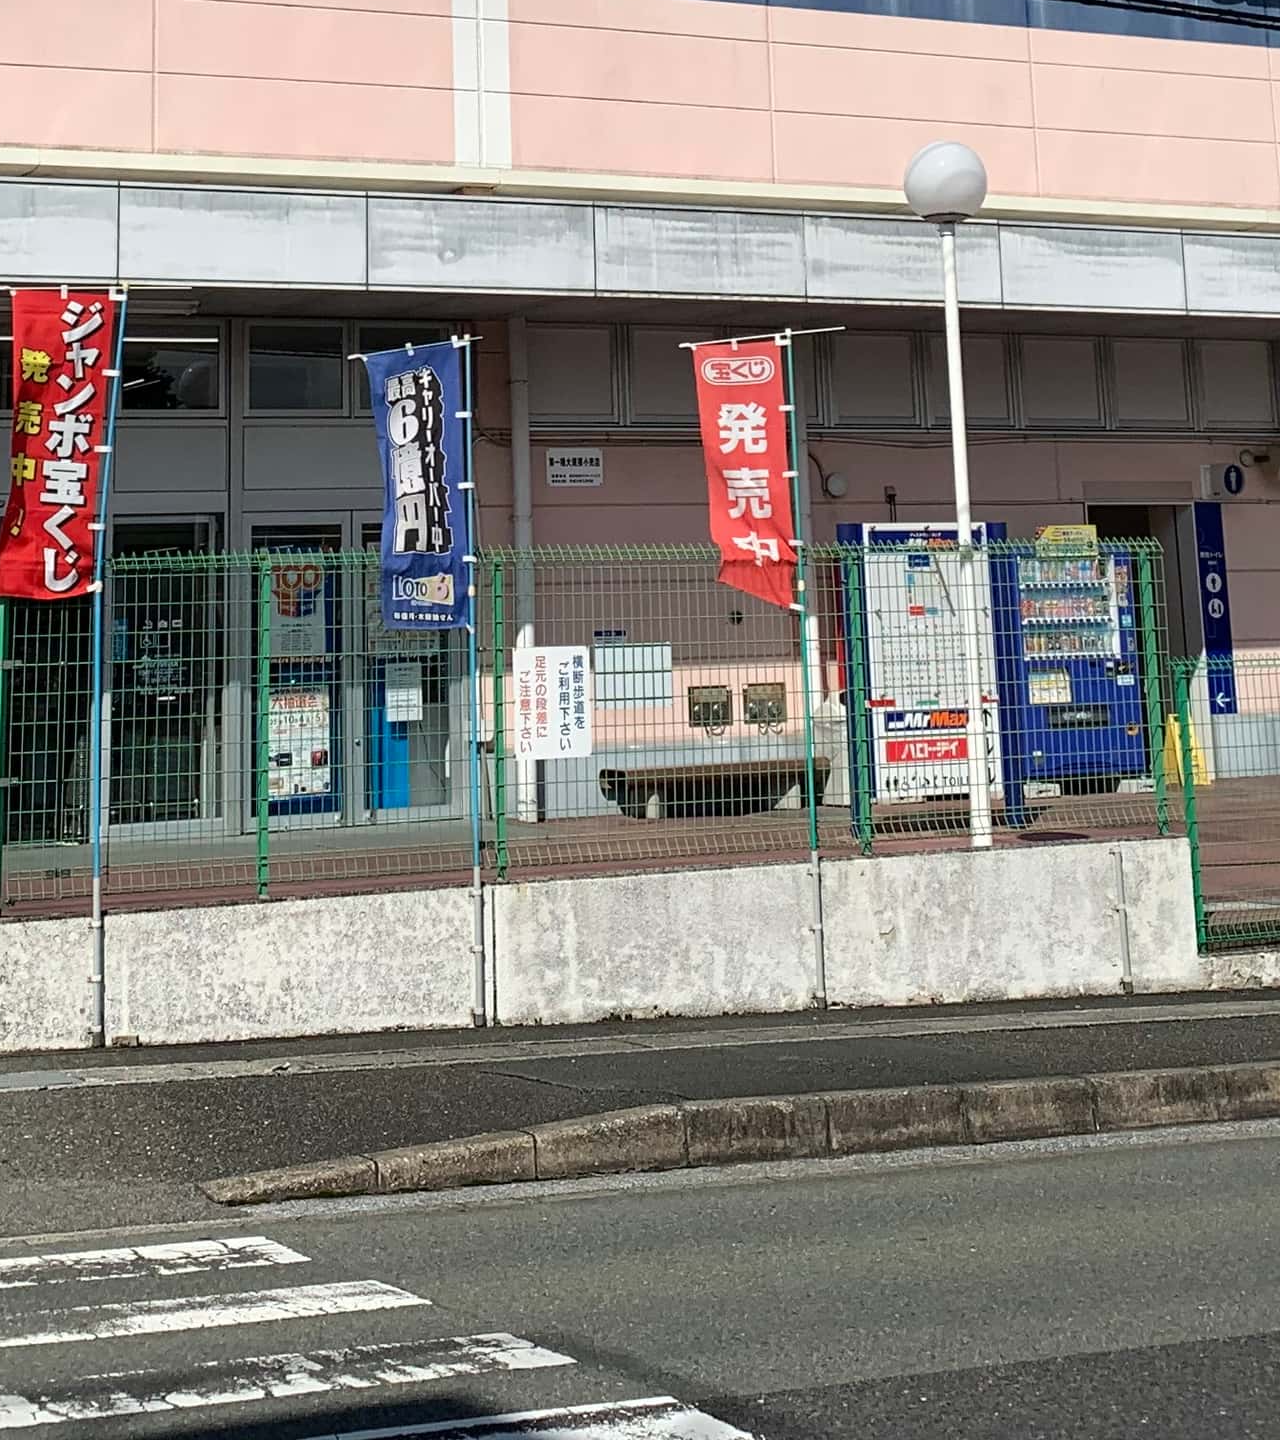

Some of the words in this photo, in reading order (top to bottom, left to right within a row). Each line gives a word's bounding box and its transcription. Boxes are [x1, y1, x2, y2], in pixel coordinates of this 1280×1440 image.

[711, 360, 765, 381] 宝くじ
[39, 300, 103, 592] ジャンボ宝くじ
[389, 398, 428, 553] 6億円
[419, 367, 444, 553] キャリーオーバー中
[717, 402, 780, 567] 発売中
[393, 575, 428, 600] LOTO
[519, 670, 533, 753] ご注意下さい
[534, 655, 548, 738] 足元の段差に
[558, 661, 572, 752] ご利用下さい
[572, 655, 586, 730] 横断歩道を
[888, 711, 969, 729] MrMax
[942, 774, 969, 787] TOIL
